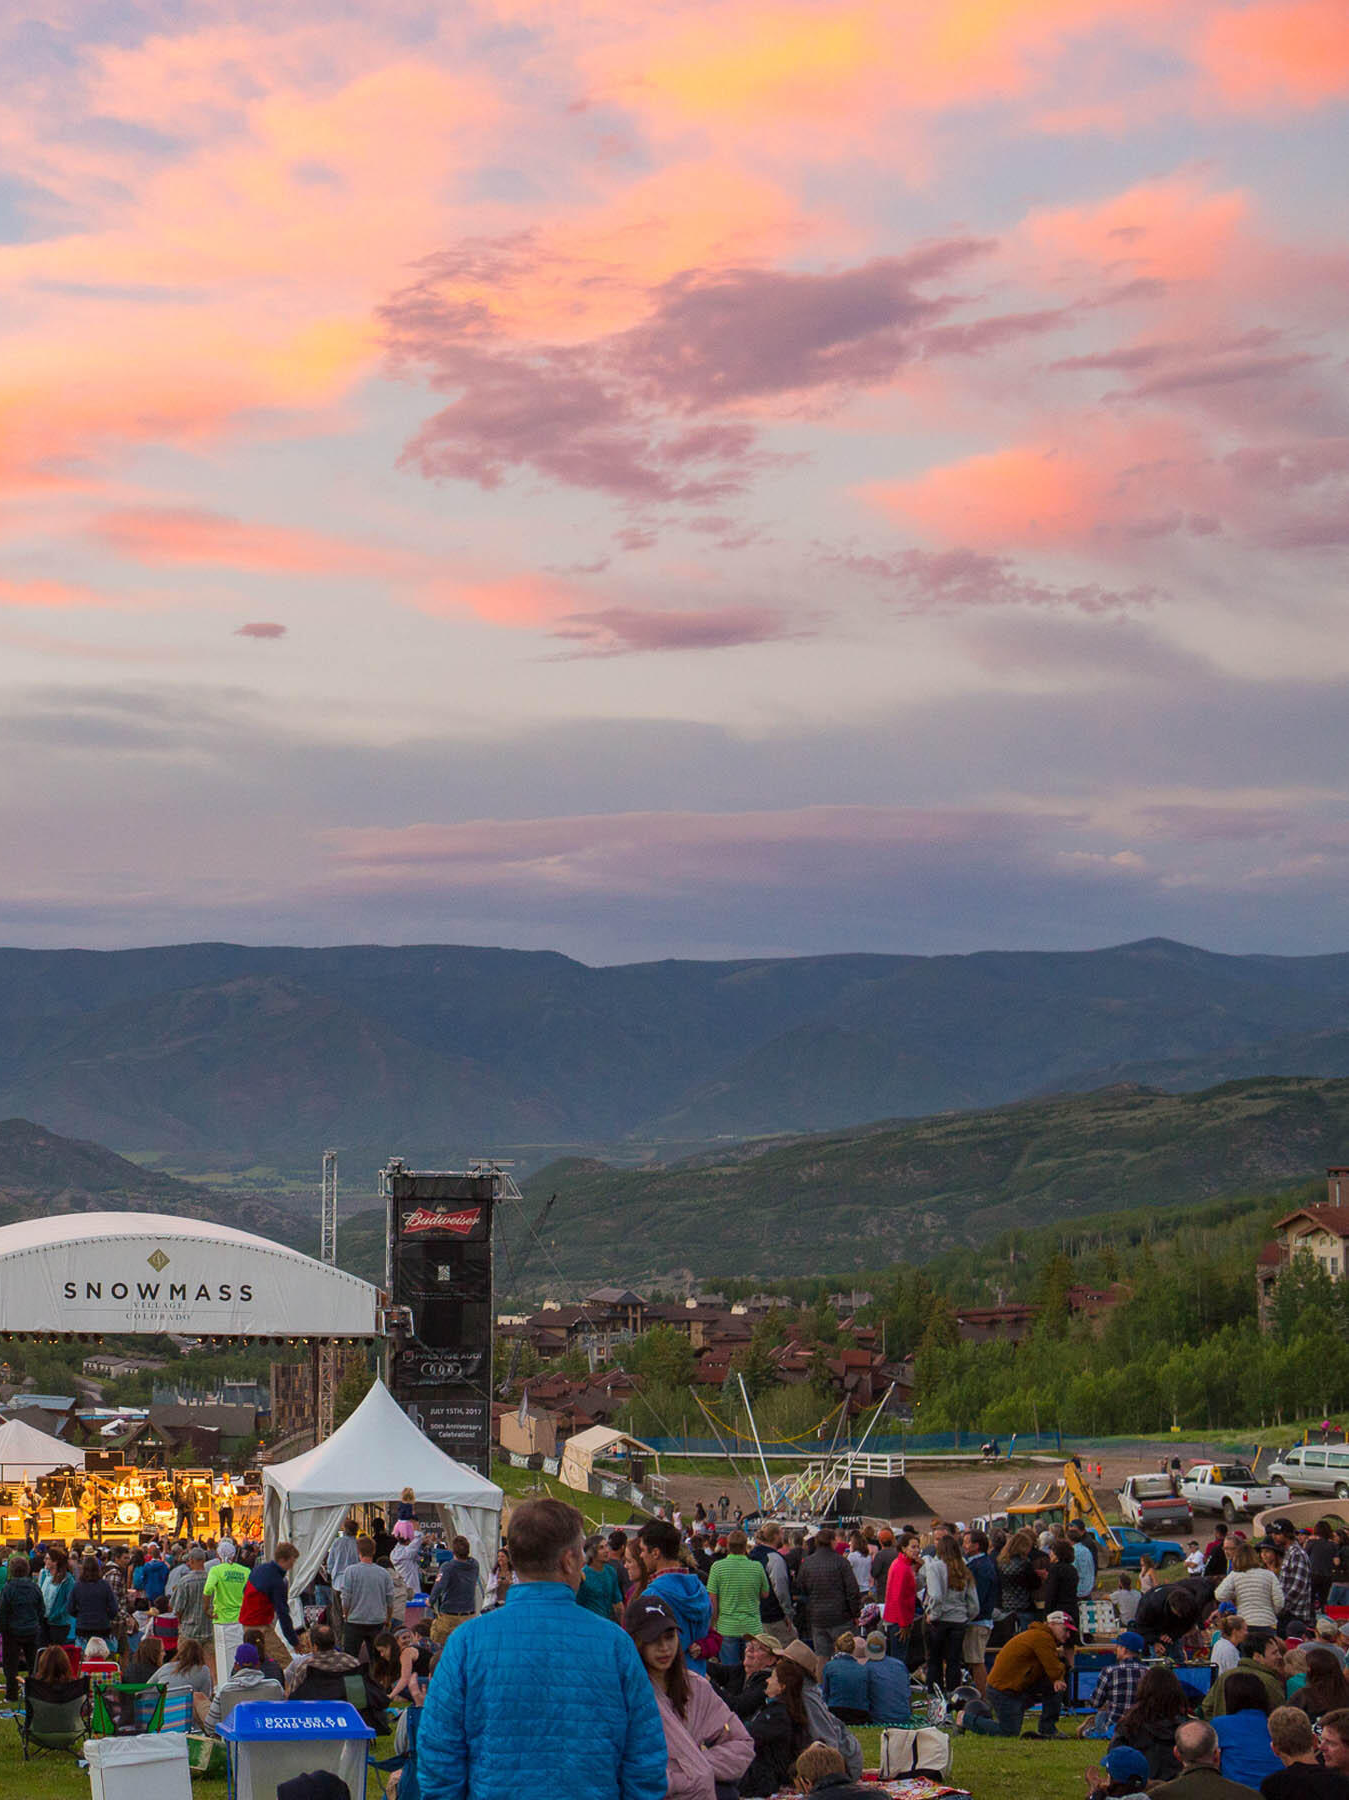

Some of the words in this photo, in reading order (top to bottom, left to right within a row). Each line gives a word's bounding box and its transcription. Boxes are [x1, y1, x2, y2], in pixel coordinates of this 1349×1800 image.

[401, 1211, 481, 1227] Budweiser
[63, 1281, 254, 1302] SNOWMASS
[133, 1301, 184, 1310] VILLAGE
[125, 1312, 191, 1322] COLORADO
[430, 1407, 445, 1416] JULY
[465, 1408, 482, 1416] 2017
[445, 1423, 483, 1432] Anniversary
